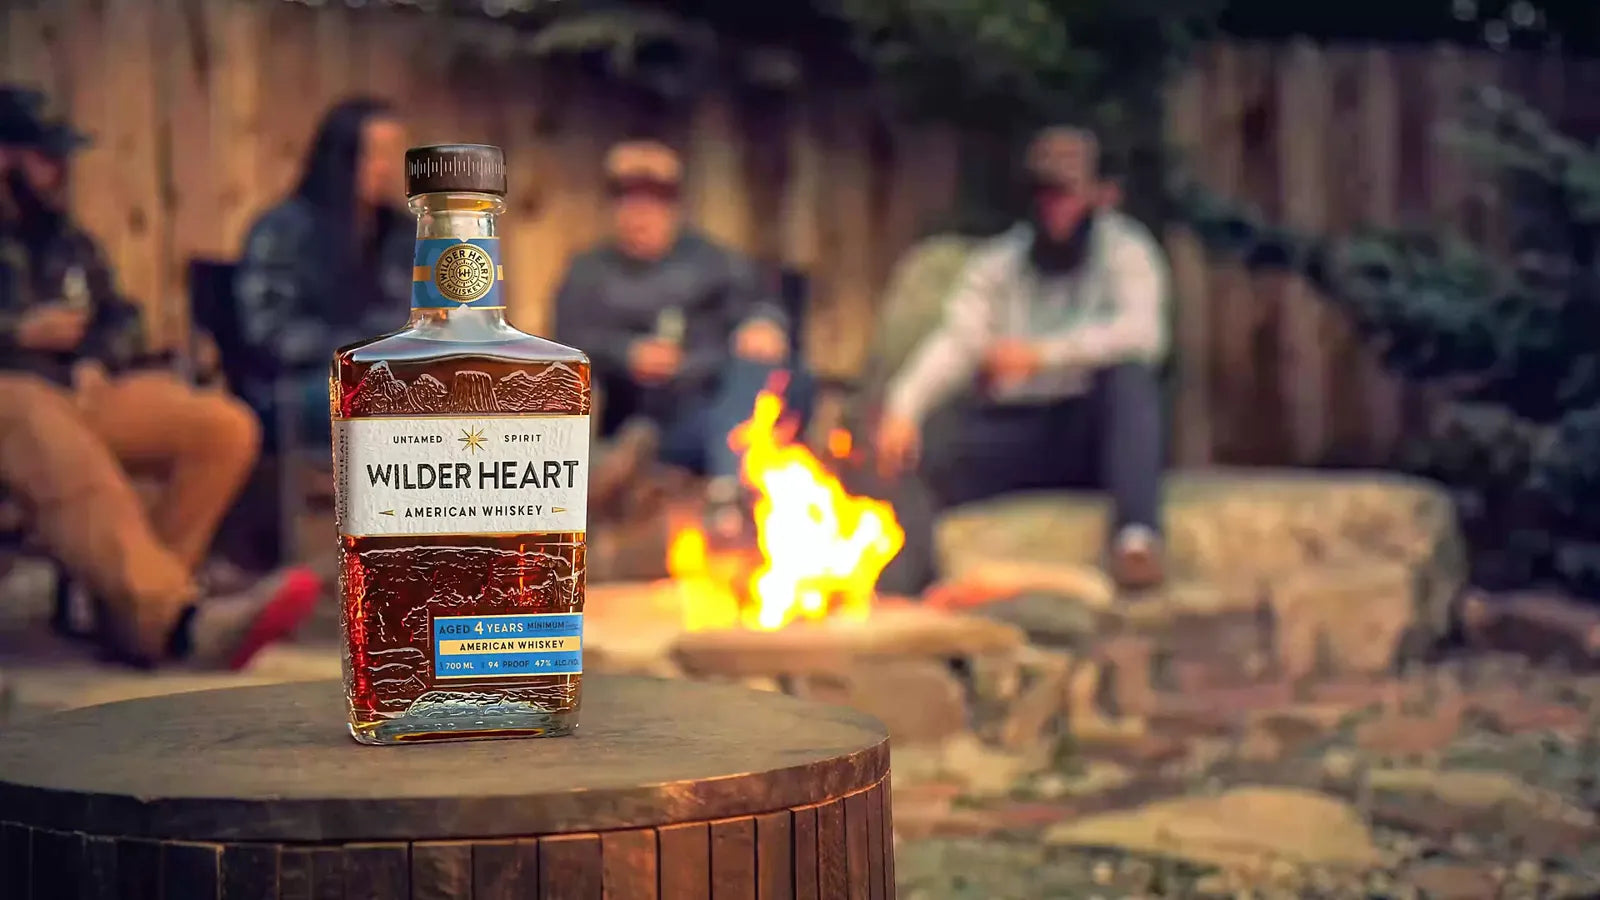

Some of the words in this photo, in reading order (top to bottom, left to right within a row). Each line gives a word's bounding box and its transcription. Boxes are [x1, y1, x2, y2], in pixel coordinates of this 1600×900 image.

[440, 250, 465, 281] WILDER
[468, 251, 488, 281] HEART
[446, 282, 482, 295] WHISKEY
[393, 435, 443, 444] UNTAMED
[504, 434, 542, 443] SPIRIT
[366, 463, 472, 490] WILDER
[479, 460, 579, 489] HEART
[405, 506, 477, 518] AMERICAN
[482, 505, 543, 517] WHISKEY
[439, 624, 471, 635] AGED
[474, 621, 484, 635] 4
[486, 622, 524, 633] YEARS
[527, 621, 565, 629] MINIMUM
[460, 641, 514, 651] AMERICAN
[518, 640, 565, 650] WHISKEY
[446, 662, 463, 670] 700
[463, 661, 474, 669] ML
[488, 661, 499, 669] 94
[502, 660, 530, 668] PROOF
[535, 659, 552, 667] 47%
